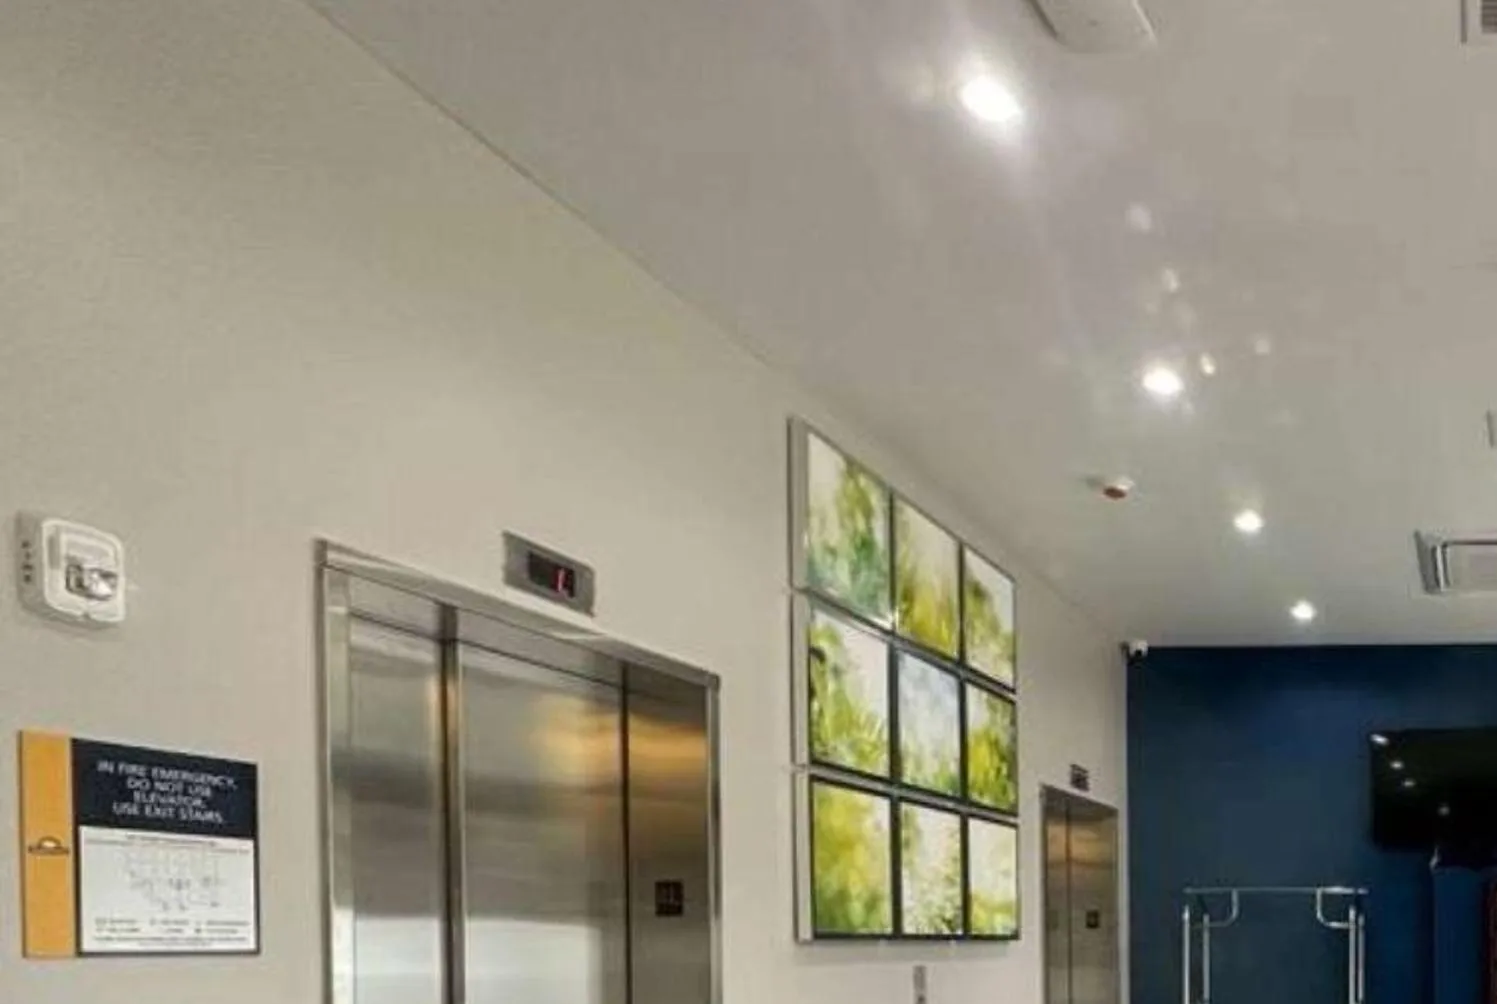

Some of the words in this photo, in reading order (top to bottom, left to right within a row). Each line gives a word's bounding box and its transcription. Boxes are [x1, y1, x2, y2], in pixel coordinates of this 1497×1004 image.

[97, 760, 115, 773] IN
[118, 762, 147, 777] FIRE
[127, 776, 151, 791] DO
[154, 780, 184, 794] NOT
[188, 784, 212, 798] USE
[112, 801, 139, 815] USE
[144, 804, 176, 818] EXIT
